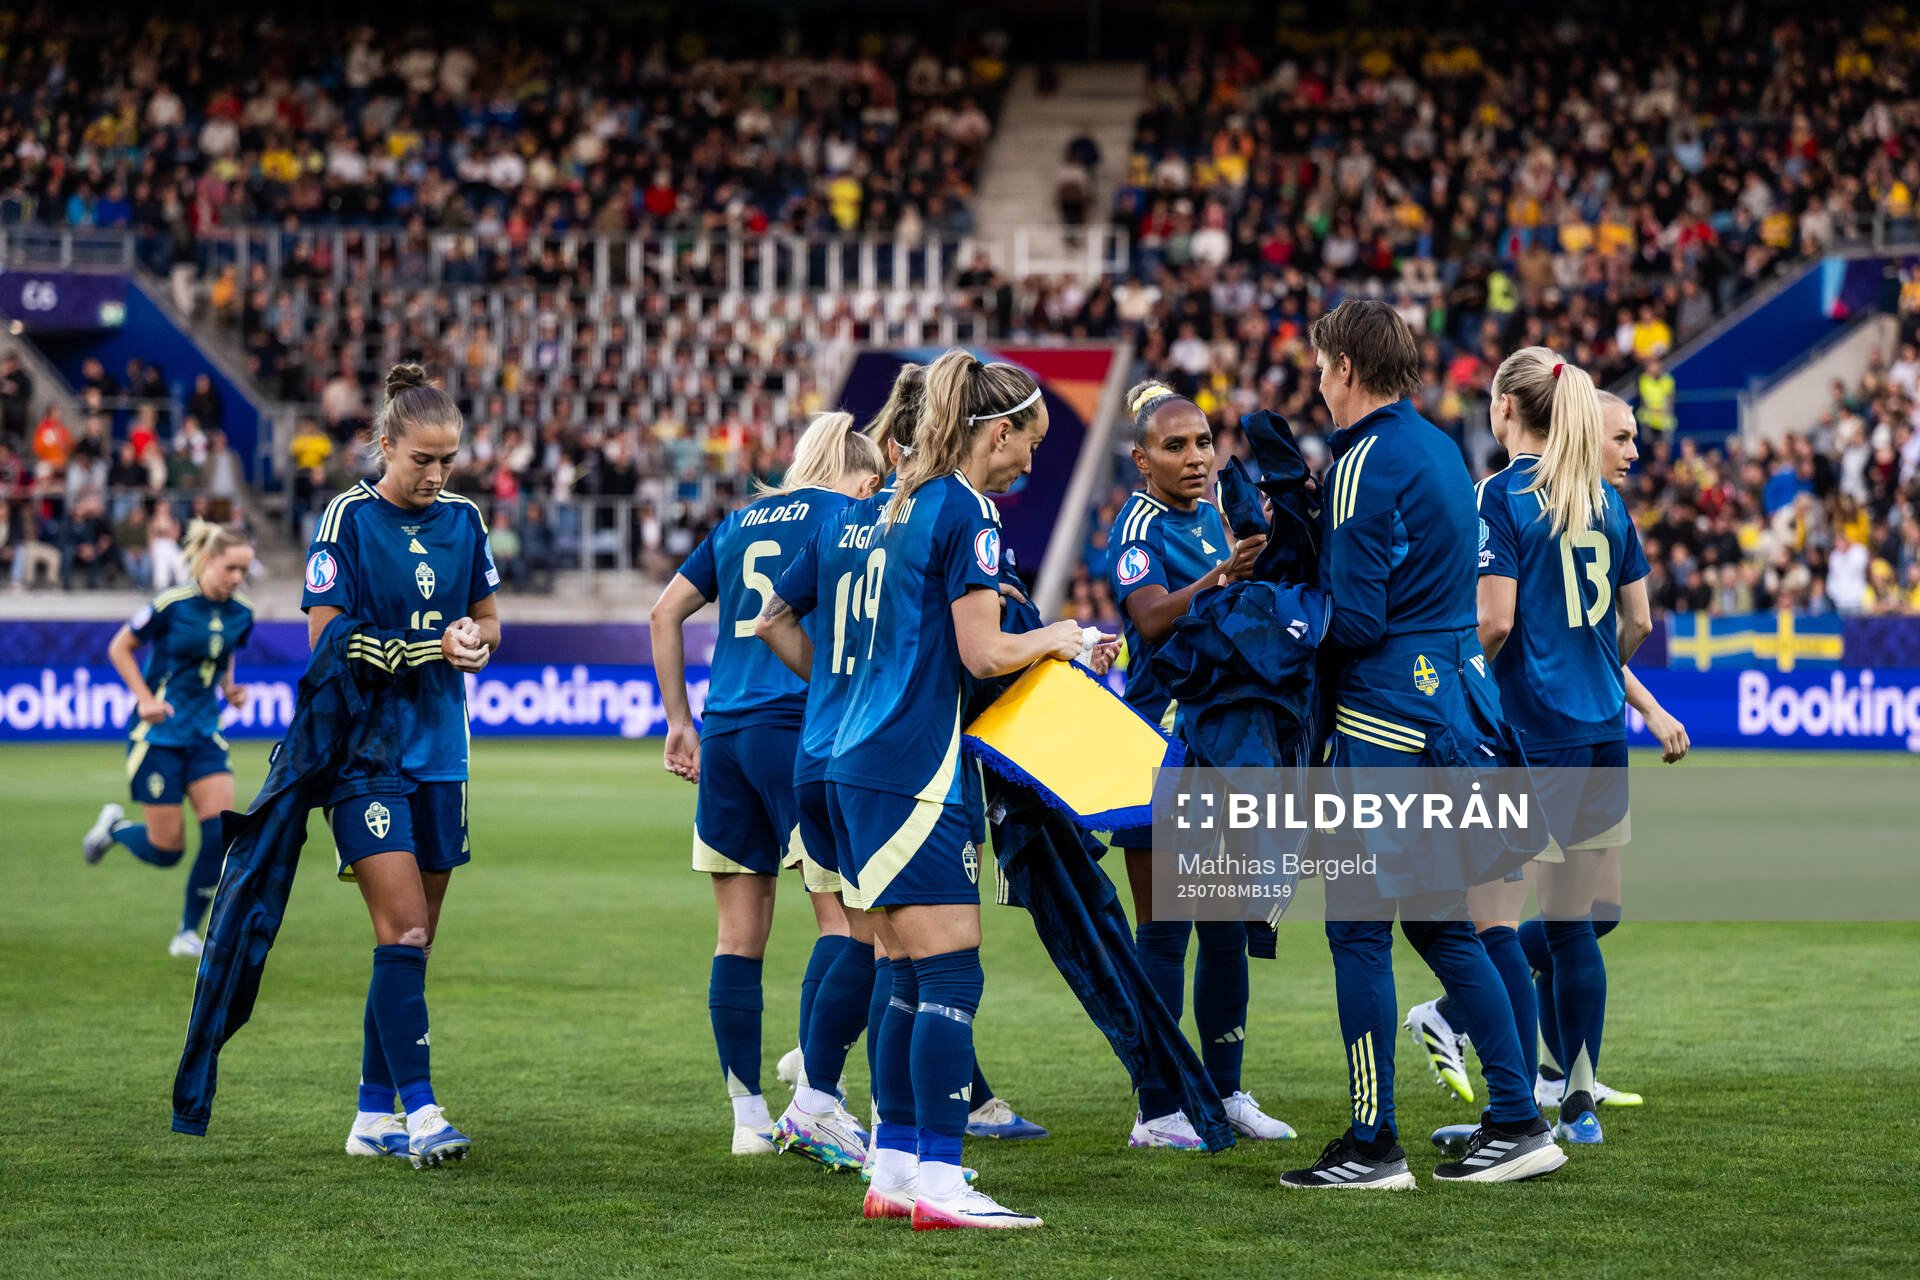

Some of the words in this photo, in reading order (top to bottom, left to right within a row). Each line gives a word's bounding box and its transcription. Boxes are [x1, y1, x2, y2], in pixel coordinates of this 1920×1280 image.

[838, 524, 875, 549] ZIGI
[1560, 530, 1611, 628] 13
[734, 540, 782, 638] 5
